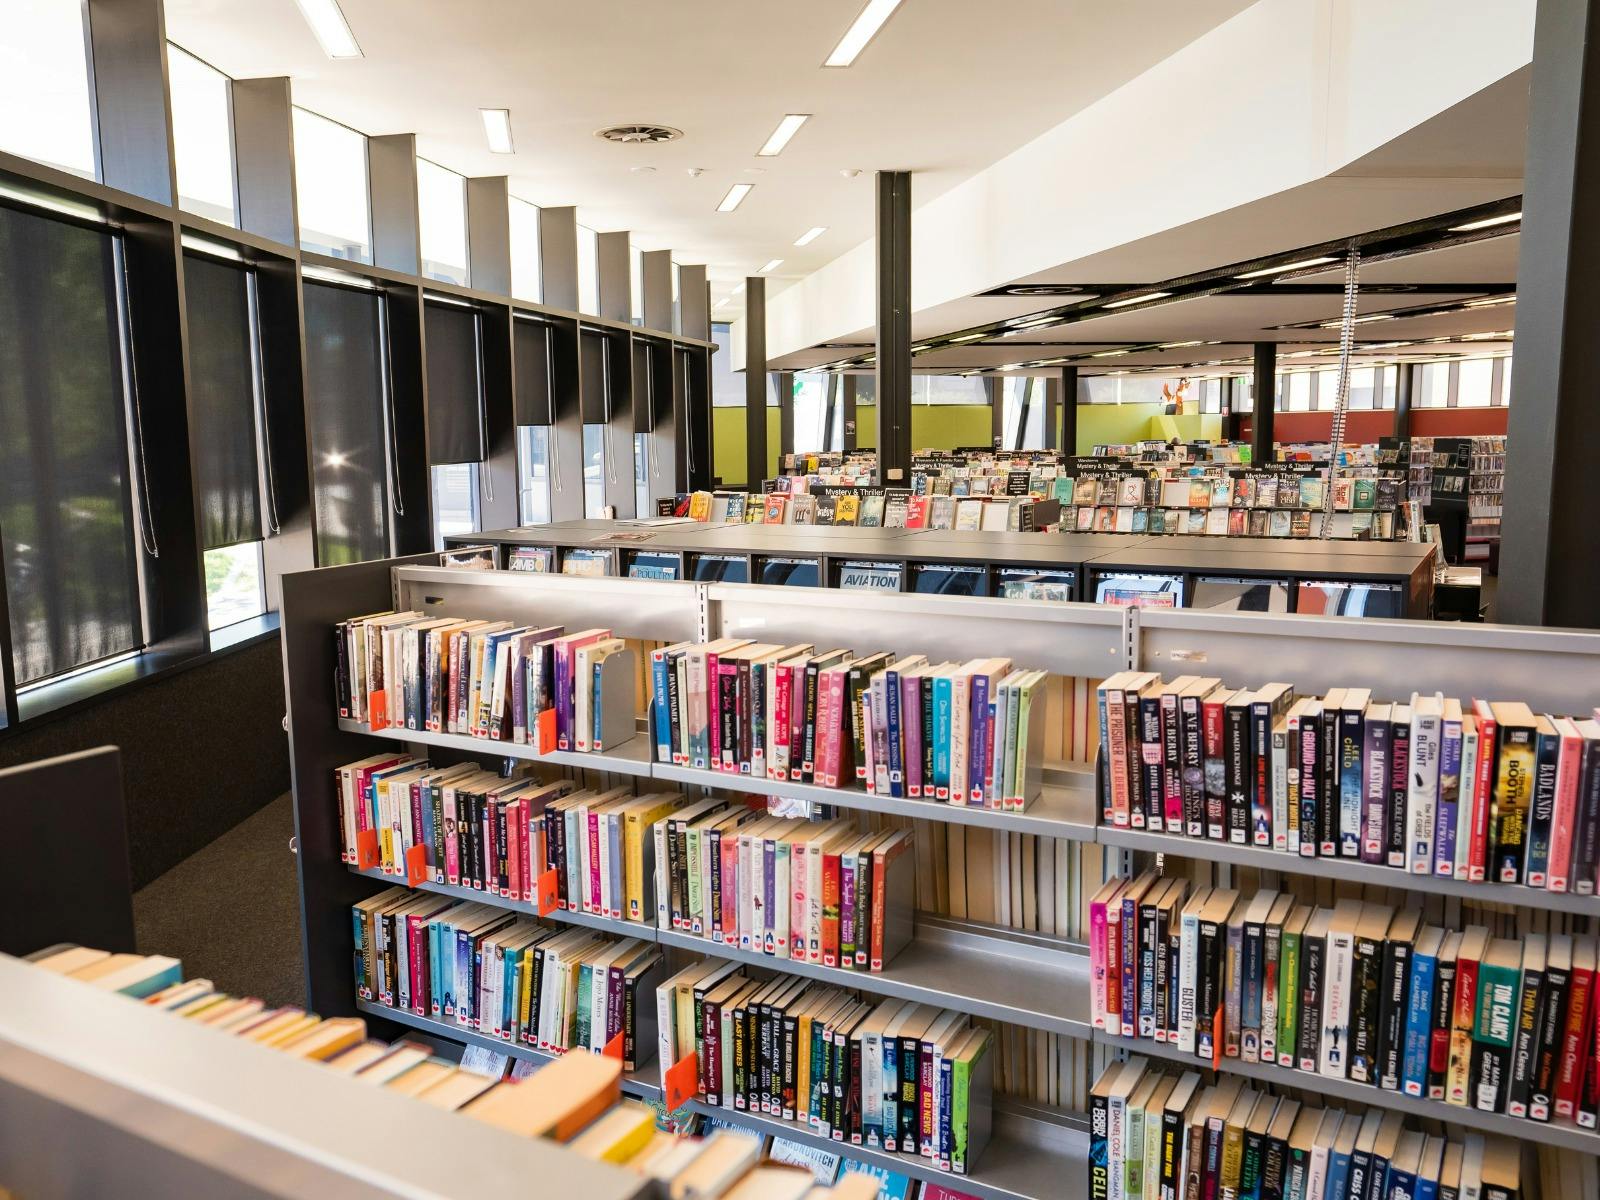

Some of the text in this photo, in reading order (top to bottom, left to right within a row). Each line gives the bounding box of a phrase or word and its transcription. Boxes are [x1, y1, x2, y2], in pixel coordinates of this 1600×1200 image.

[1264, 462, 1284, 470] Mystery
[825, 488, 884, 496] Mystery & Thriller
[844, 574, 897, 589] AVIATION
[669, 673, 678, 723] DIANA PALMER
[805, 738, 813, 761] ROBERTS
[1110, 703, 1126, 808] THE PRISONER BERENSON
[1166, 728, 1178, 763] BERRY
[1188, 732, 1199, 767] BERRY
[1232, 730, 1241, 786] MALTA EXCHANGE
[1325, 725, 1333, 772] Benjamin Black
[1344, 737, 1353, 768] CHILD
[1352, 744, 1360, 761] LEE
[1416, 734, 1427, 767] BLUNT
[1427, 742, 1436, 760] Giles
[1150, 765, 1159, 789] CAPITOL
[1302, 731, 1316, 800] GROUND HALT
[1368, 750, 1385, 799] BLACKSTOCK
[1506, 760, 1520, 804] BOOTH
[1165, 768, 1174, 799] VENDETTA
[1173, 778, 1181, 797] PARIS
[1289, 784, 1299, 804] TOAST
[1343, 791, 1351, 810] LINE
[1391, 739, 1408, 846] BLACKSTOCK DOUBLE MINDS
[1517, 768, 1527, 799] STEPHEN
[1536, 763, 1556, 821] BADLANDS
[1184, 784, 1193, 823] DECEPTION
[1192, 789, 1201, 819] KING'S
[1231, 807, 1239, 828] BERRY
[1350, 772, 1359, 831] THE MIDNIGHT
[1415, 818, 1423, 839] GRIEF
[1424, 815, 1432, 839] FIELDS
[1513, 808, 1523, 845] DANCING
[859, 865, 867, 911] Benedict's Bride
[595, 980, 604, 995] Jojo
[1142, 951, 1154, 1012] KISS HER GOODBYE
[1157, 942, 1166, 1026] KEN BRUEN THE DEVIL
[1411, 974, 1421, 1024] CHAMBERLAIN
[1181, 987, 1194, 1022] GLISTER
[1331, 984, 1340, 1022] DEFENCE
[1389, 961, 1404, 1061] FIRST THRILLS LEE
[1420, 989, 1429, 1012] DIANE
[1490, 983, 1513, 1042] TOM CLANCY
[1264, 1002, 1277, 1035] STRAND
[1302, 1006, 1312, 1049] HARDCOVER
[1311, 1008, 1319, 1043] HOMICIDE
[1515, 988, 1537, 1081] THIN AIR Ann Cleeves
[1563, 988, 1586, 1083] WILD FIRE Ann Cleeves
[735, 1018, 744, 1067] LAST WRITES
[1356, 1031, 1367, 1052] WELL
[923, 1091, 932, 1135] BAD NEWS
[1093, 1107, 1101, 1135] COOK
[1112, 1109, 1121, 1198] DANIEL COLE HANGMAN
[1165, 1131, 1174, 1178] THE NIGHT FIRE
[1243, 1149, 1255, 1188] COULTER
[1093, 1166, 1106, 1199] CELL
[1292, 1164, 1304, 1190] PATRICIA
[1351, 1168, 1363, 1194] CRISS
[1374, 1171, 1382, 1186] CLIVE
